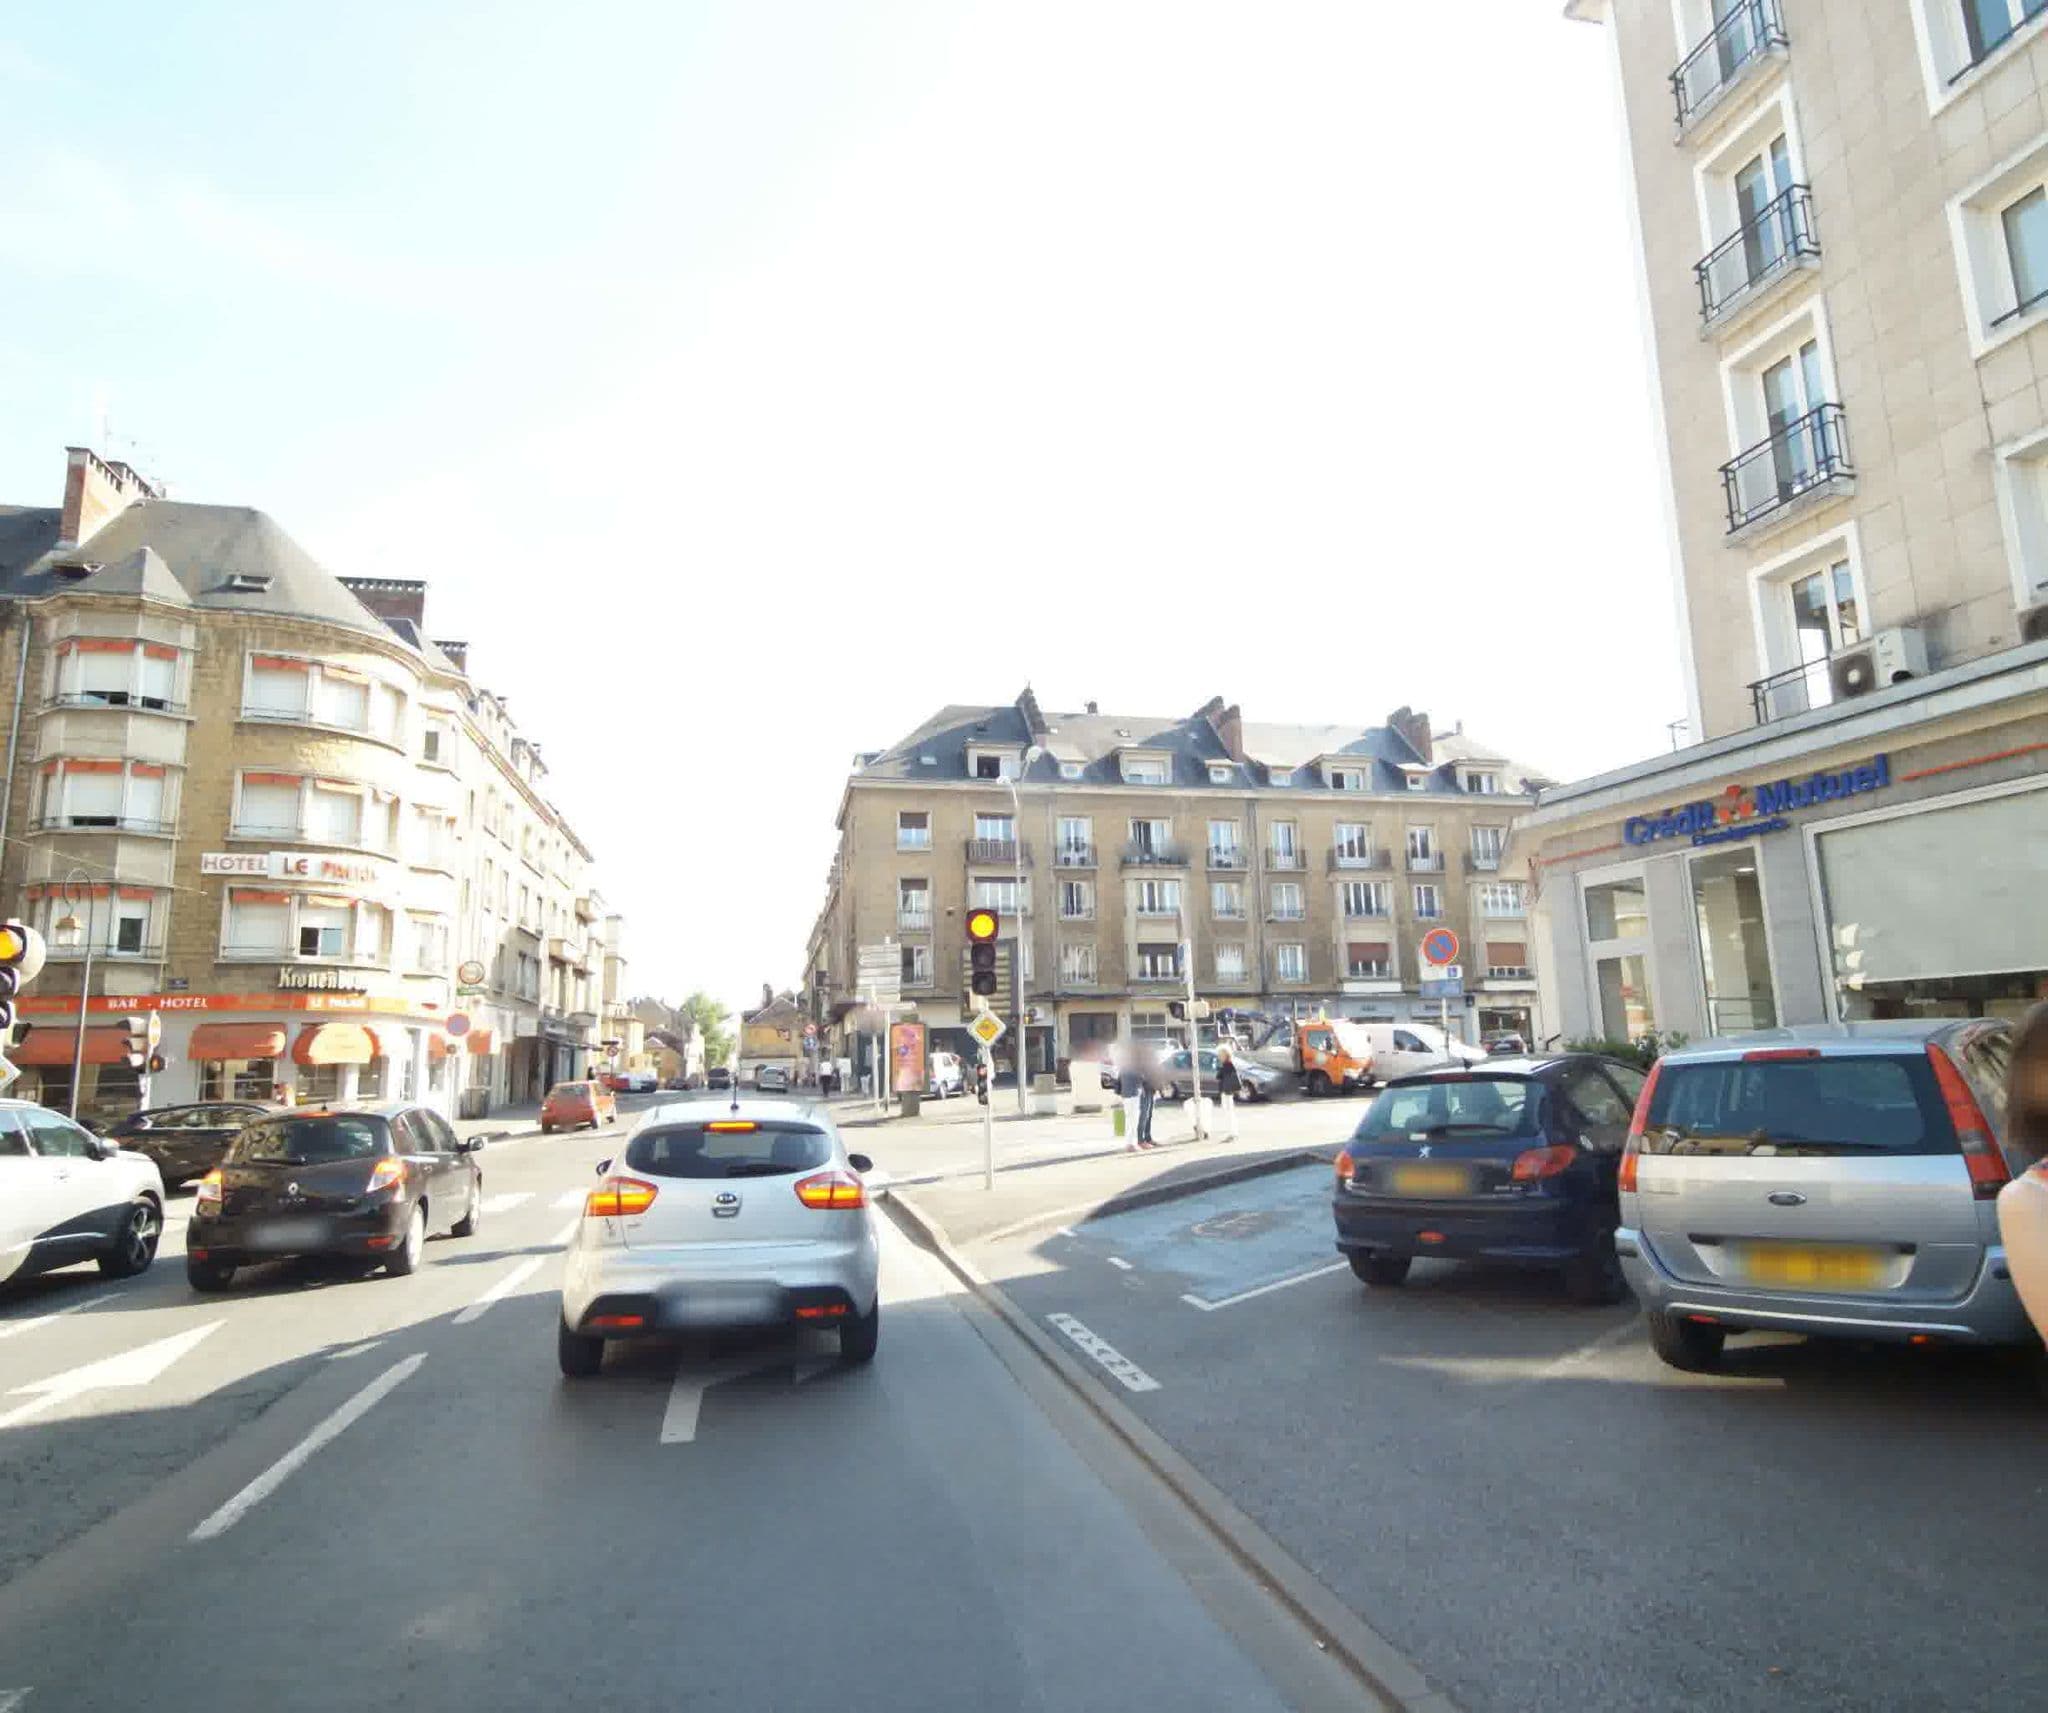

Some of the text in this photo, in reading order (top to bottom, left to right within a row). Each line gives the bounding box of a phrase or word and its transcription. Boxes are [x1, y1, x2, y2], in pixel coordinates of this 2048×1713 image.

[1755, 753, 1890, 816] Mutuel
[203, 856, 268, 871] HOTEL
[284, 857, 309, 875] LE
[107, 998, 138, 1010] BAR
[160, 997, 209, 1009] HOTEL
